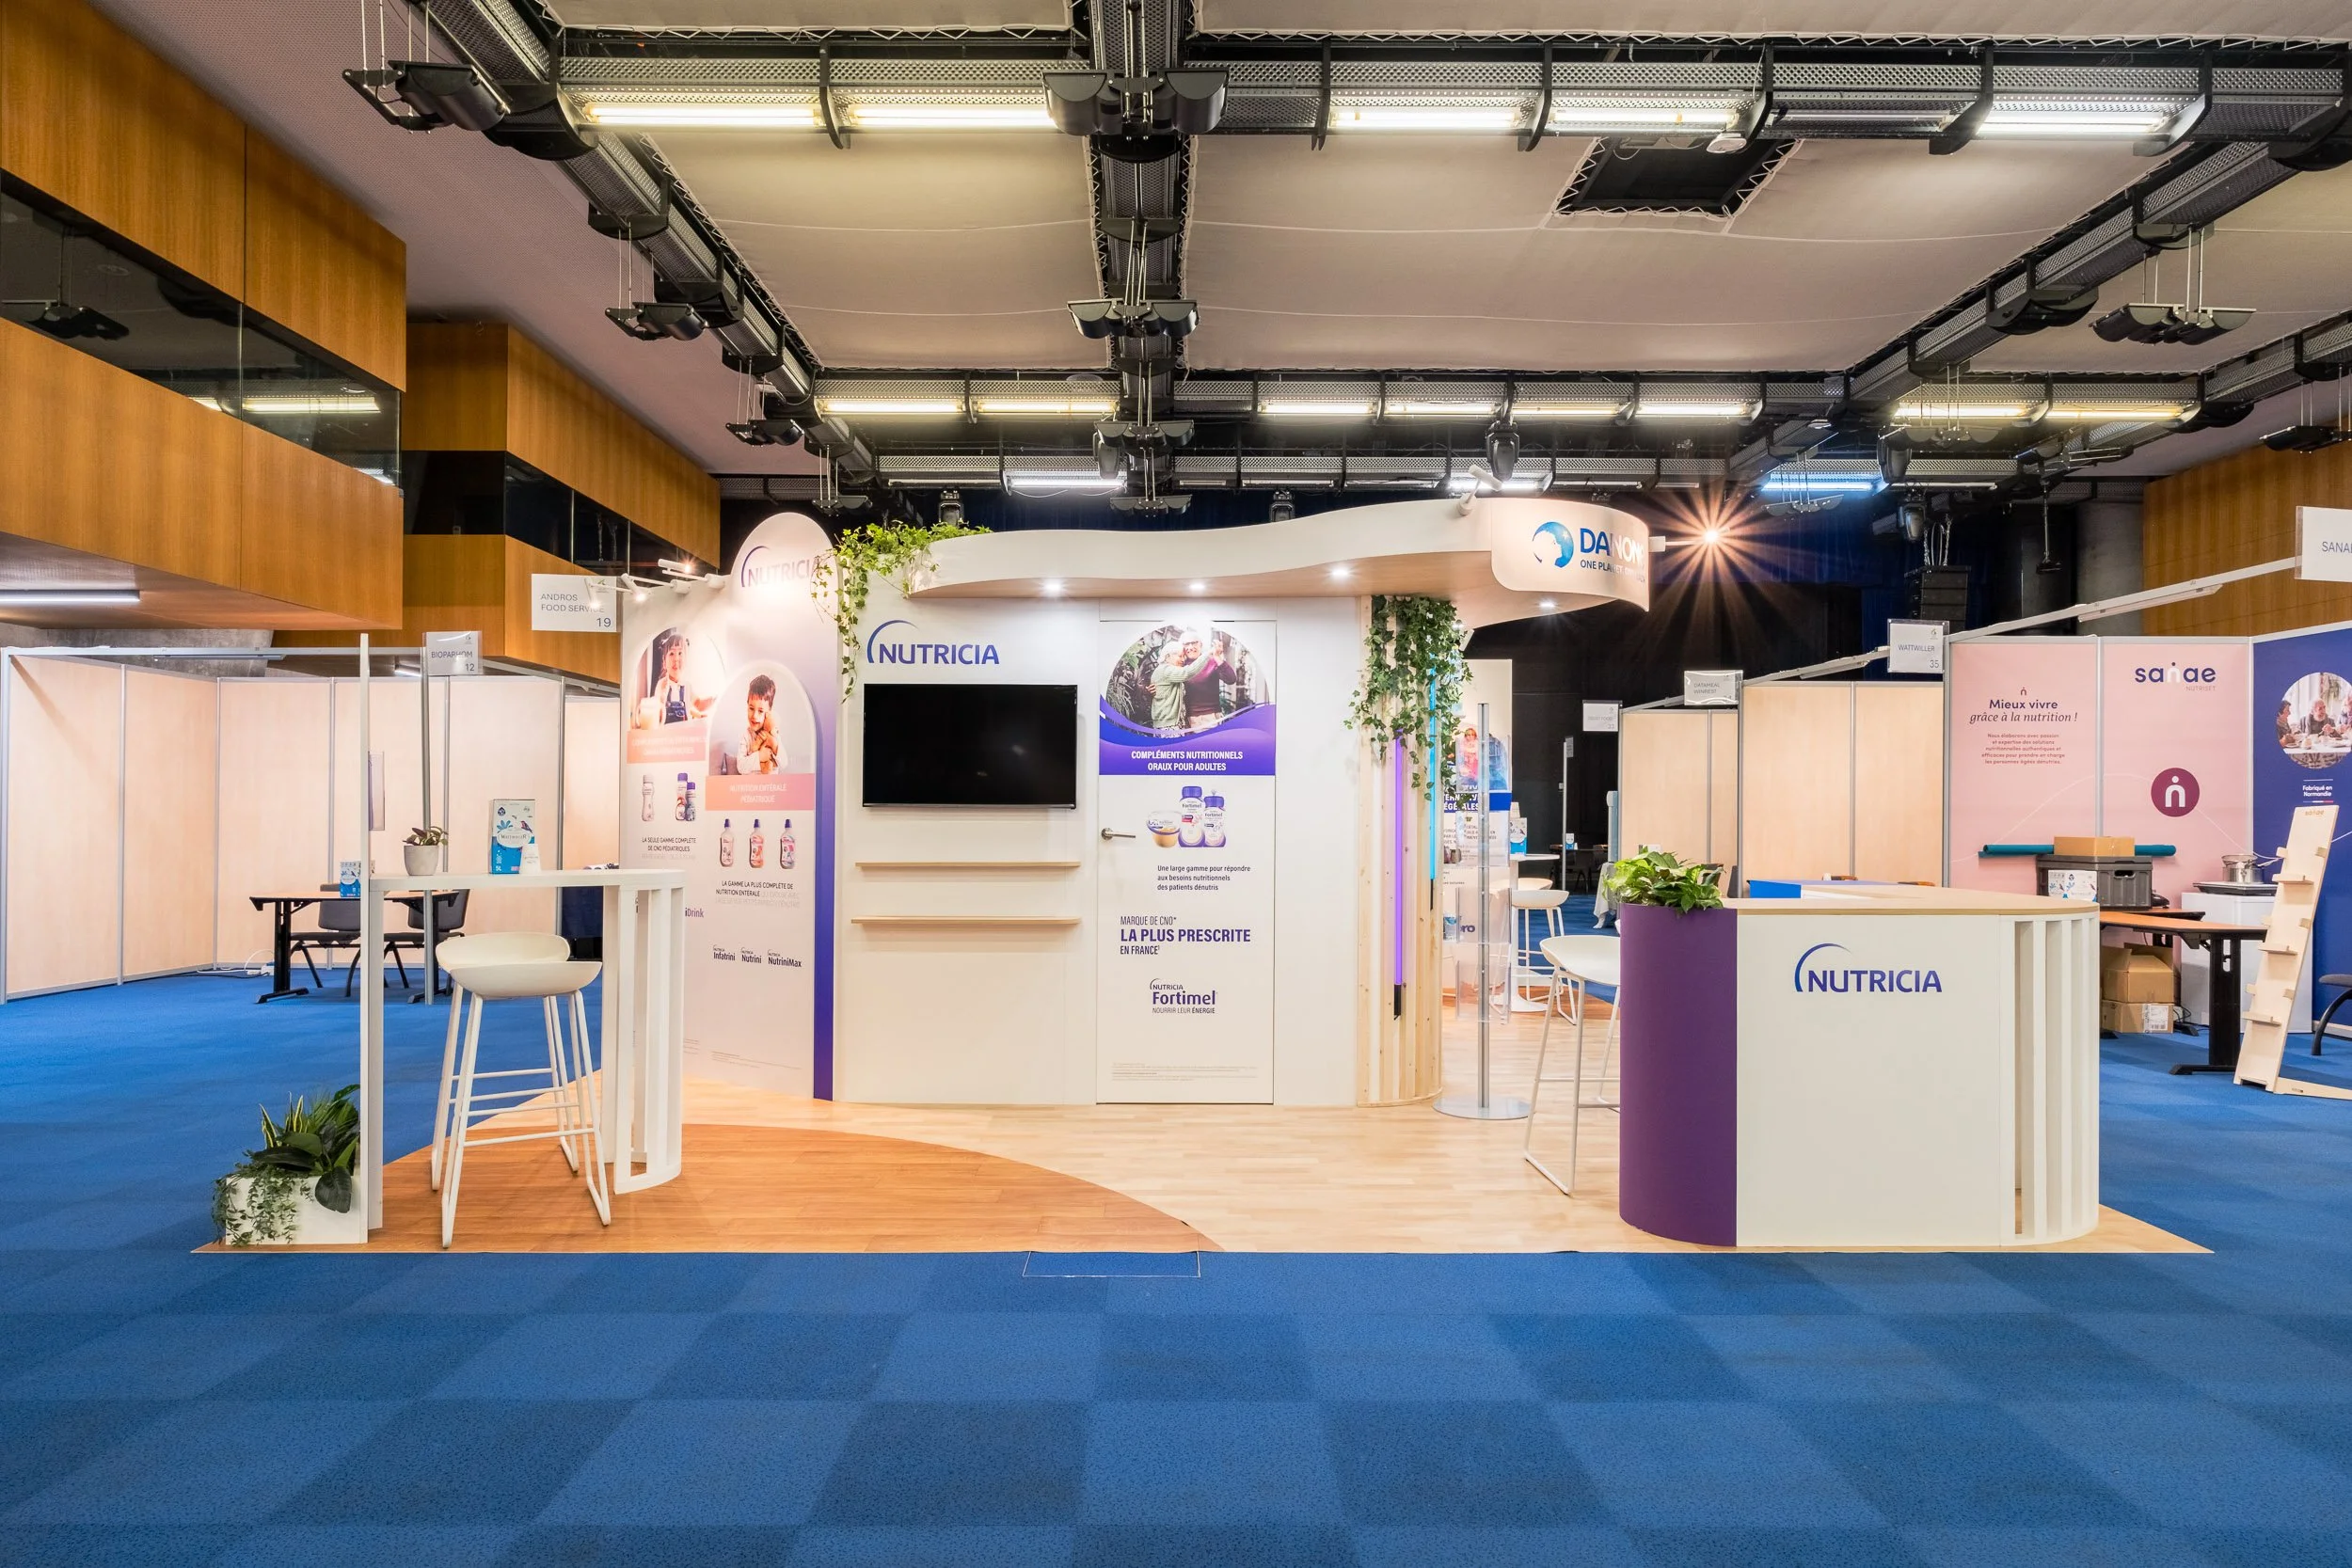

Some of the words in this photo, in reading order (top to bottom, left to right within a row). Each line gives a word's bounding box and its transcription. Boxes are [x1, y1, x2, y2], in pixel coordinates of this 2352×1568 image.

[1581, 559, 1597, 570] ONE
[541, 594, 578, 602] ANDROS
[596, 617, 612, 627] 19
[879, 643, 1000, 664] NUTRICIA
[465, 663, 474, 672] 12
[1930, 659, 1939, 669] 35
[1989, 700, 2026, 708] Mieux
[2029, 699, 2058, 708] vivre
[1969, 712, 1998, 724] grâce
[2001, 712, 2008, 721] à
[2010, 712, 2020, 721] la
[2024, 713, 2071, 721] nutrition
[1131, 750, 1185, 760] COMPLÉMENTS
[1186, 752, 1244, 760] NUTRITIONNELS
[1148, 763, 1172, 771] ORAUX
[1174, 763, 1194, 771] POUR
[1195, 763, 1227, 771] ADULTES
[1169, 864, 1185, 873] large
[1224, 864, 1251, 873] répondre
[1168, 883, 1193, 892] patients
[1120, 915, 1149, 926] MARQUE
[1150, 916, 1159, 926] DE
[1120, 928, 1137, 942] LA
[1140, 928, 1175, 942] PLUS
[1178, 928, 1251, 942] PRESCRITE
[1120, 945, 1130, 955] EN
[713, 951, 736, 961] Infatrini
[741, 954, 762, 963] Nutrini
[768, 957, 802, 968] NutriniMax
[1808, 970, 1942, 992] NUTRICIA
[1152, 990, 1216, 1006] Fortimel
